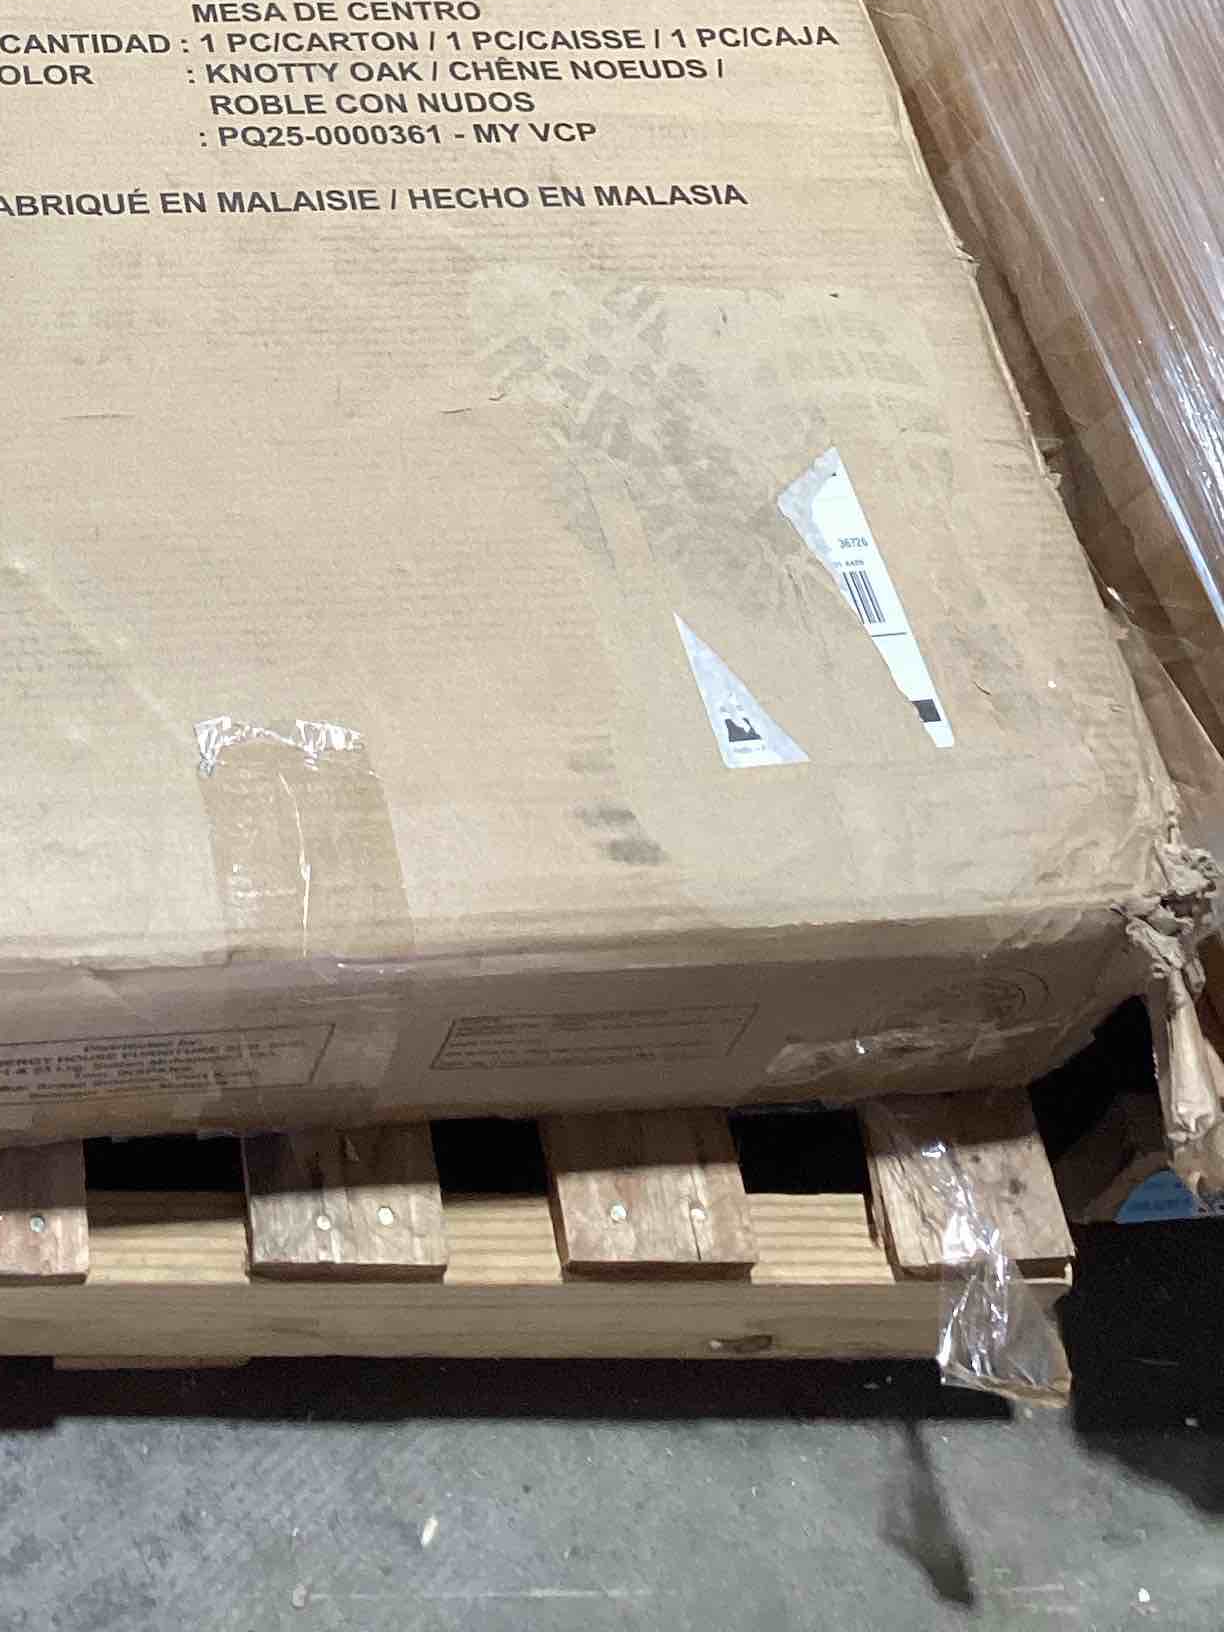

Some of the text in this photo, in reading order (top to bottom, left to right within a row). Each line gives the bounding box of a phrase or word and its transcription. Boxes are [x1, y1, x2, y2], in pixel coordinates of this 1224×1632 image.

[191, 0, 481, 23] MESA DE CENTRO
[0, 33, 171, 54] CANTIDAD
[226, 31, 419, 53] PC/CARTON
[471, 29, 646, 51] PC/CAISSE
[695, 25, 840, 48] PC/CAJA
[205, 62, 339, 84] KNOTTY
[349, 61, 423, 82] OAK
[448, 56, 563, 81] CHÊNE
[569, 59, 708, 81] NOEUDS
[209, 91, 536, 116] ROBLE CON NUDOS
[217, 124, 441, 148] PQ25-0000361
[472, 123, 520, 144] MY
[527, 122, 597, 143] VCP
[159, 191, 207, 214] EN
[216, 189, 381, 213] MALAISIE
[407, 186, 530, 210] HECHO
[537, 185, 586, 208] EN
[593, 183, 749, 207] MALASIA
